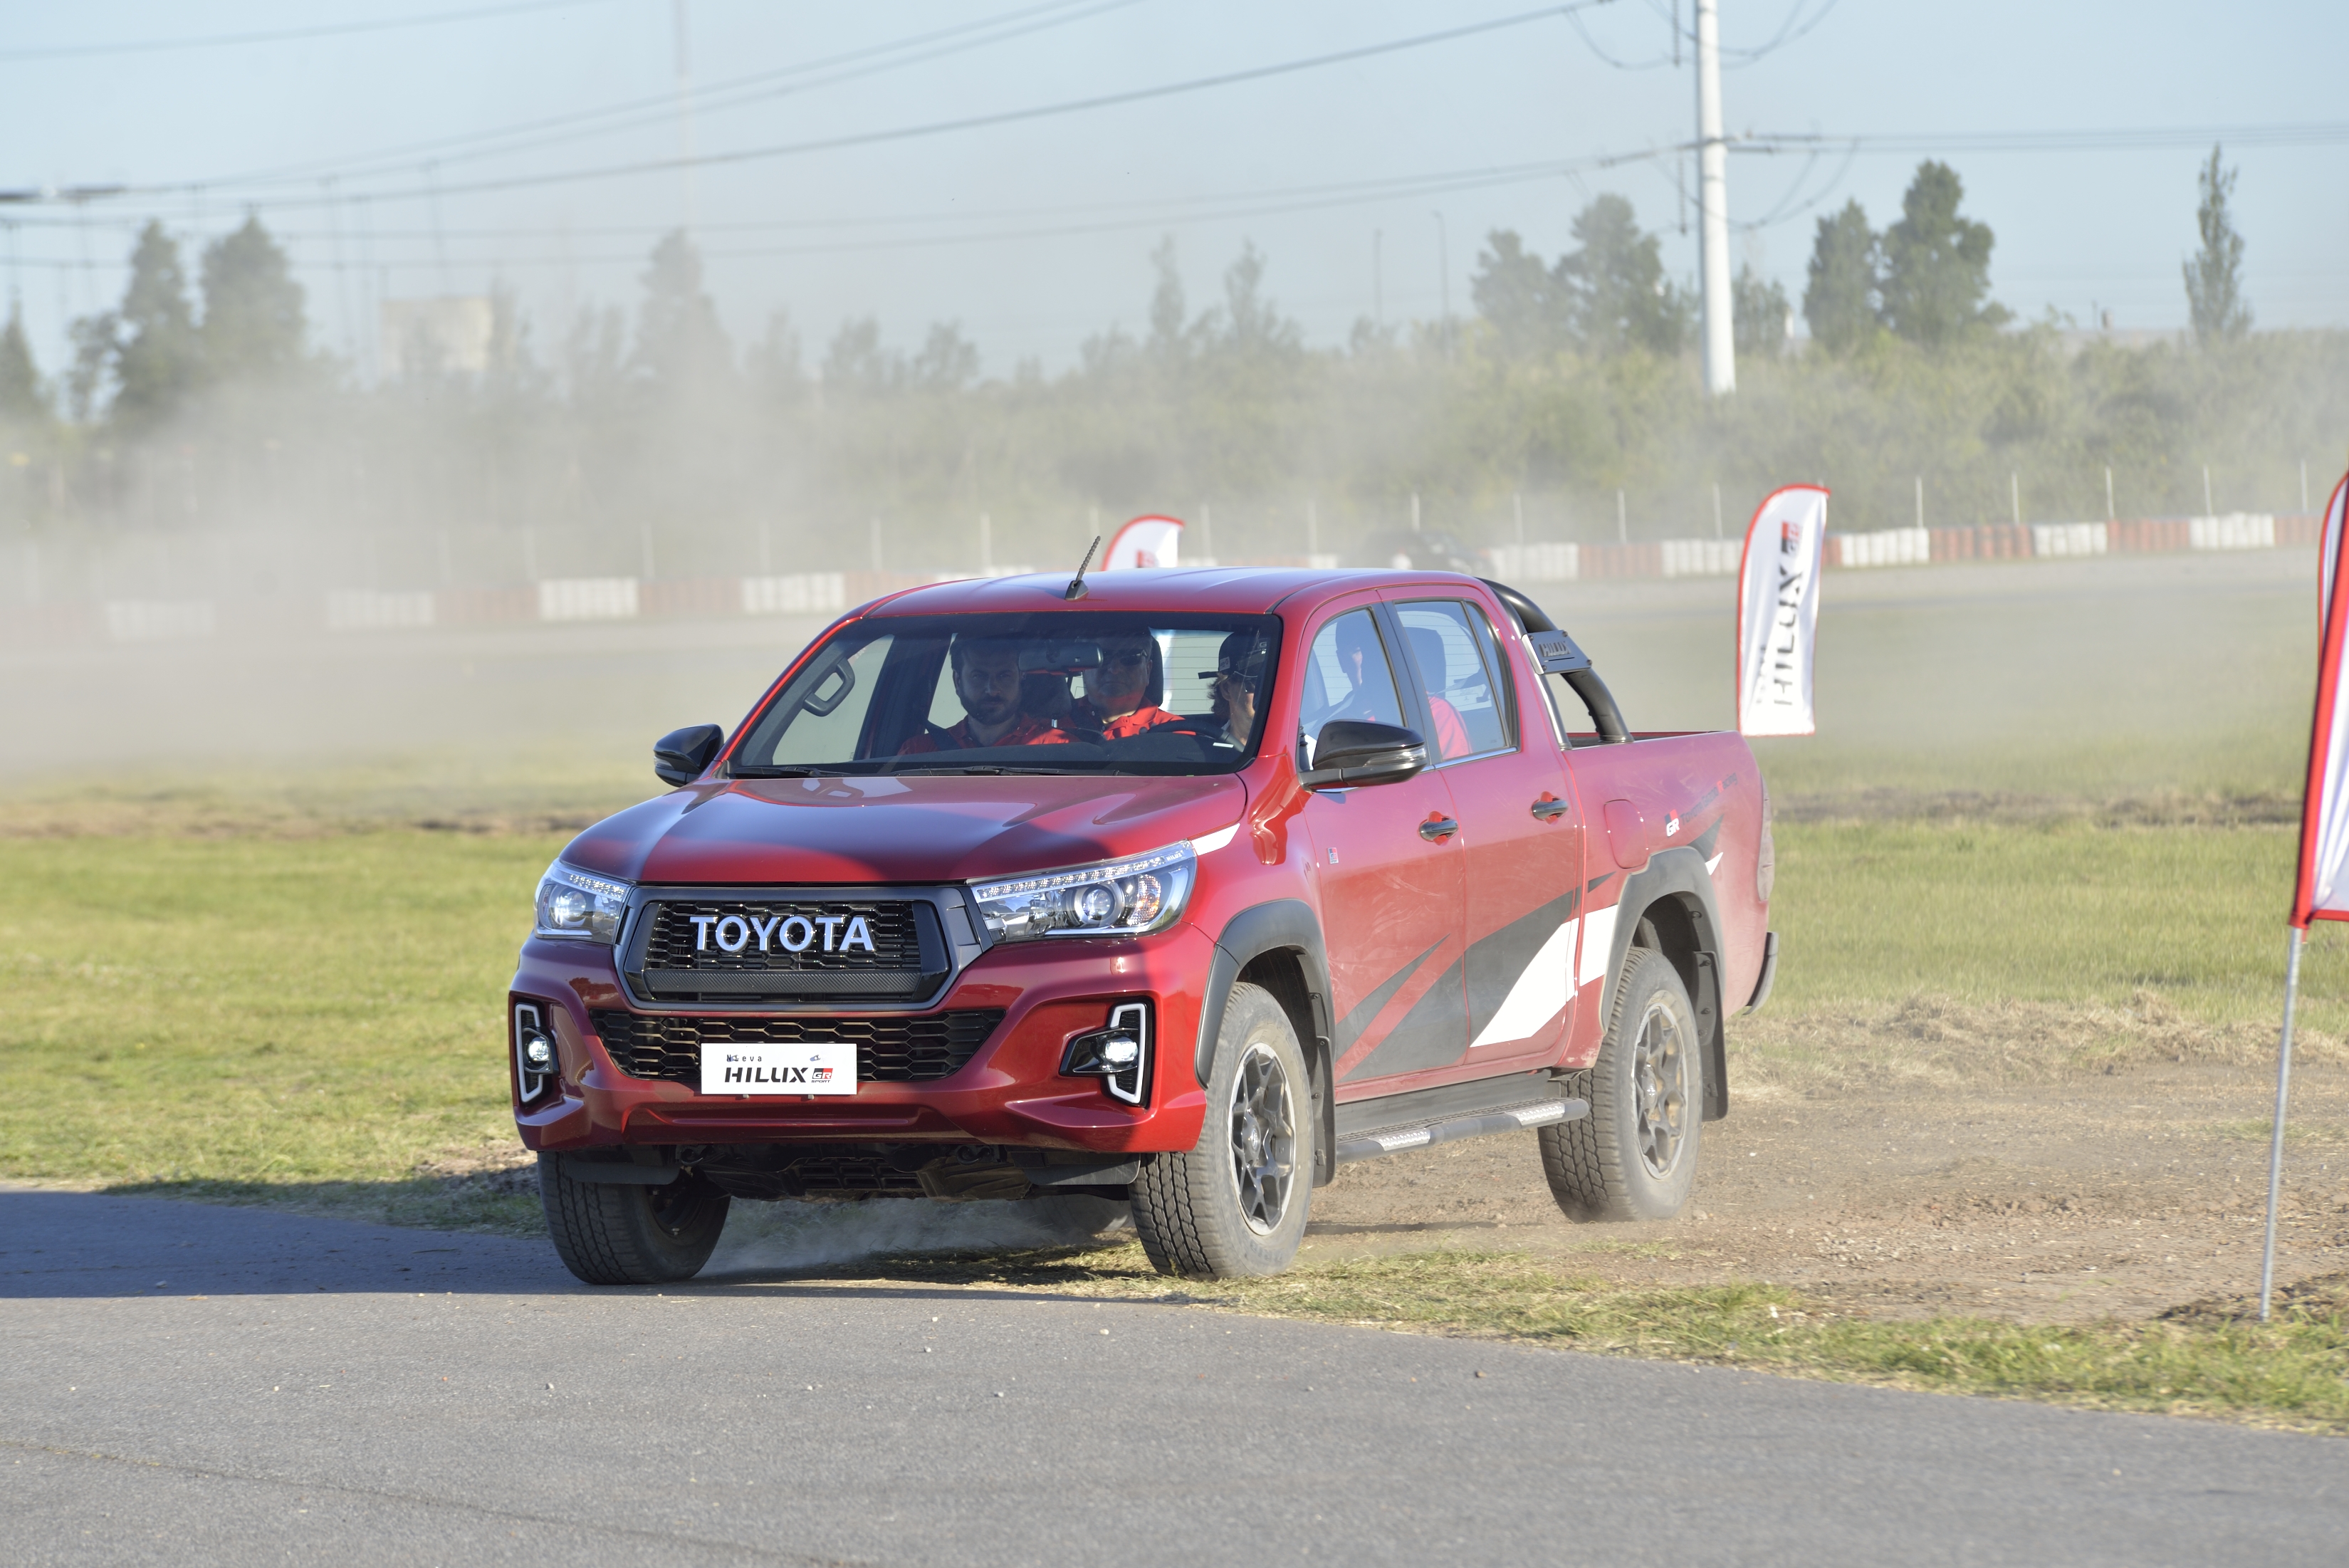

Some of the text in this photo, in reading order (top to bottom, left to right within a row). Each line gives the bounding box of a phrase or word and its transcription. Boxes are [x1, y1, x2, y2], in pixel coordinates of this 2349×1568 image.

[1774, 565, 1803, 706] HILUX
[1539, 641, 1571, 657] HILUX
[1666, 817, 1680, 837] GR
[1166, 852, 1183, 861] HILUX
[690, 915, 877, 952] TOYOTA
[725, 1067, 832, 1082] HILUX GR
